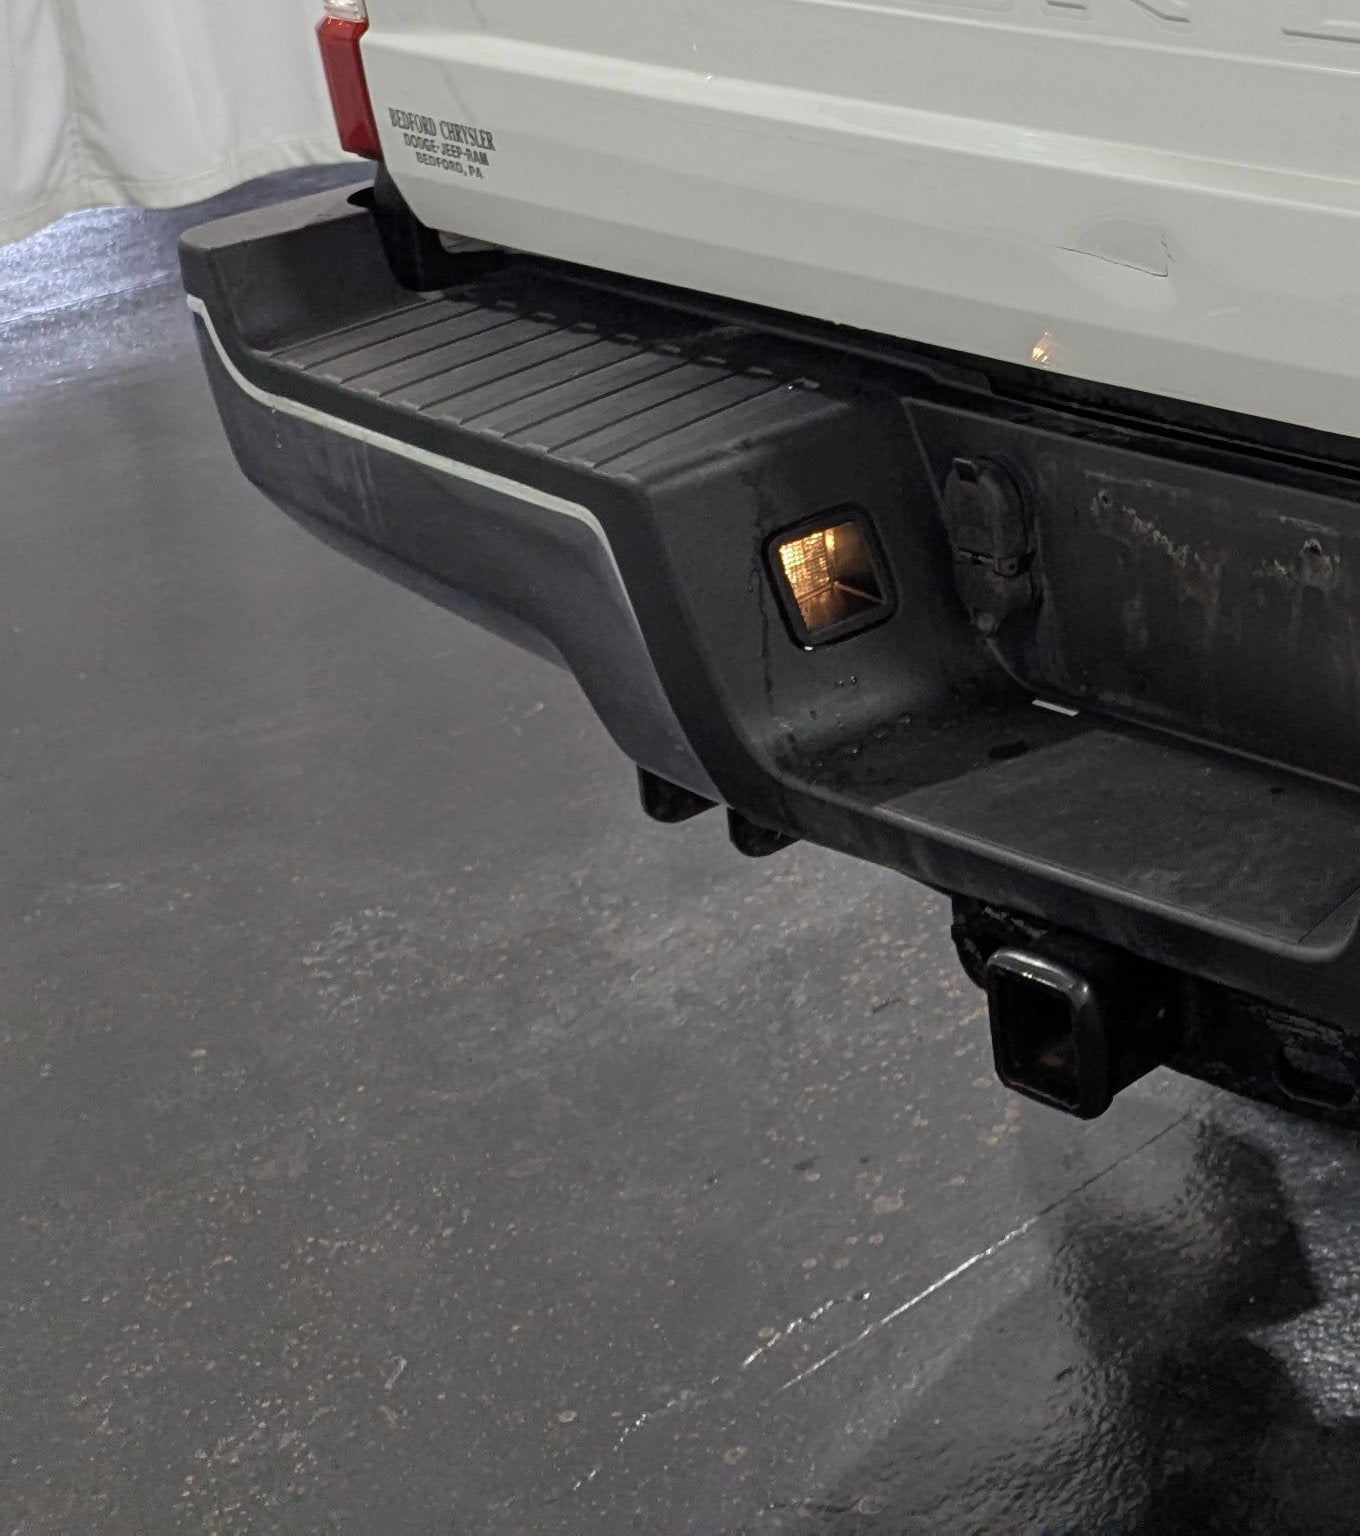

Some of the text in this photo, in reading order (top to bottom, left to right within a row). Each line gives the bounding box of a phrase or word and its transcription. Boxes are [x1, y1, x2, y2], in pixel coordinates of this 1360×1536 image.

[388, 107, 497, 152] BEDFORD CHRYSLER
[416, 151, 484, 179] BEDFORD, PA
